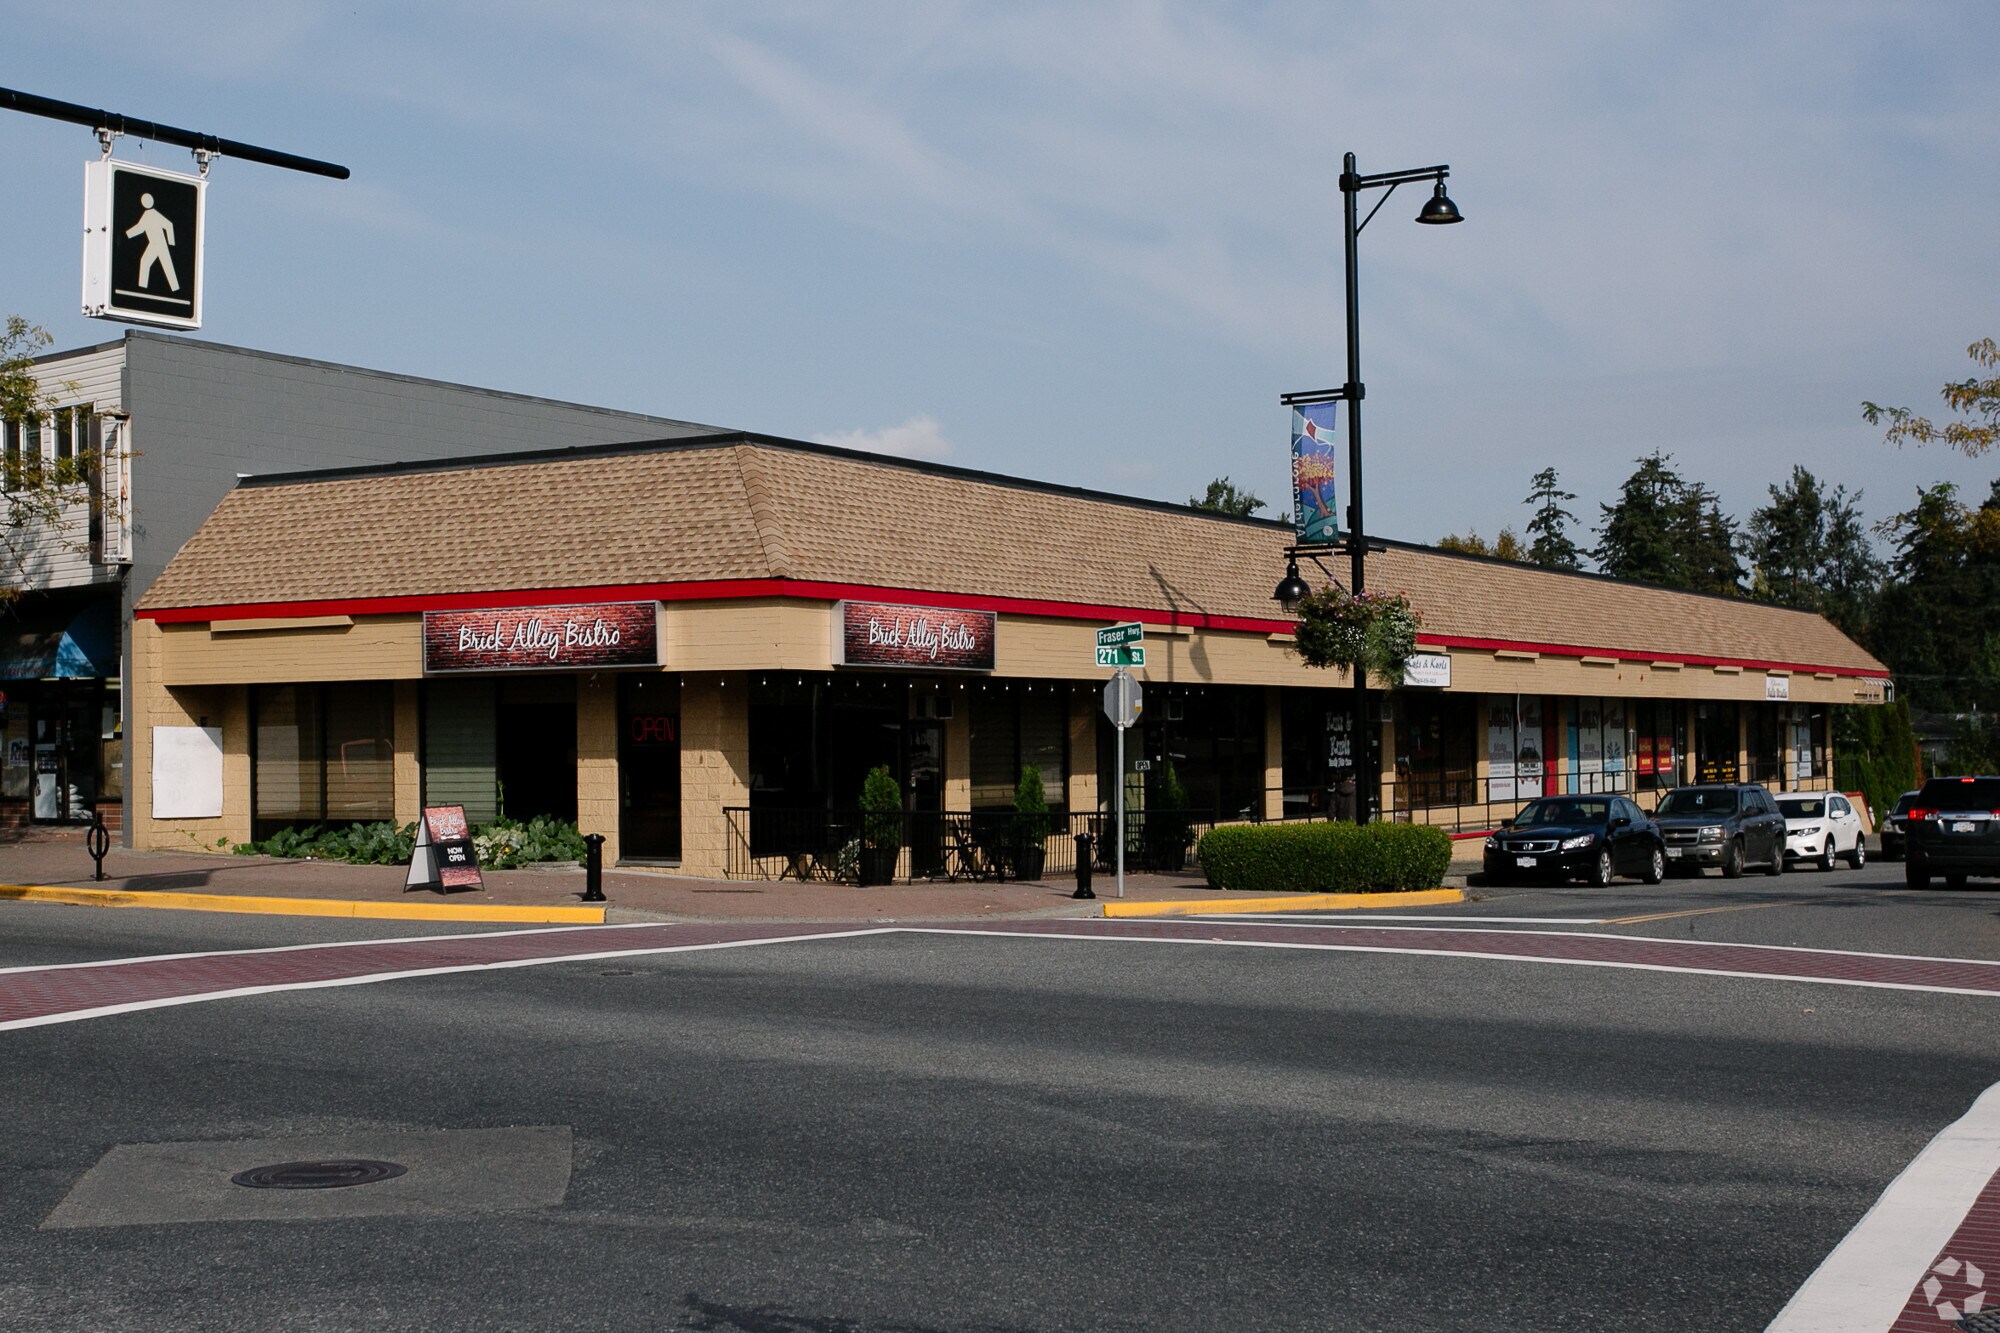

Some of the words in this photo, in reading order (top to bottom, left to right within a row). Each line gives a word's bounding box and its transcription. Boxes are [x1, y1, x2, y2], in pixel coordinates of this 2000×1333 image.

[458, 620, 504, 651] Brick
[508, 618, 560, 659] Alley
[564, 619, 620, 648] Bistro
[869, 617, 902, 648] Brick
[903, 618, 938, 659] Alley
[940, 622, 975, 650] Bistro
[1098, 630, 1125, 645] Fraser
[1099, 649, 1118, 664] 271
[1423, 659, 1428, 668] &
[632, 717, 674, 741] OPEN
[1137, 761, 1149, 769] OPEN
[447, 847, 463, 855] NOW
[448, 854, 466, 862] OPEN
